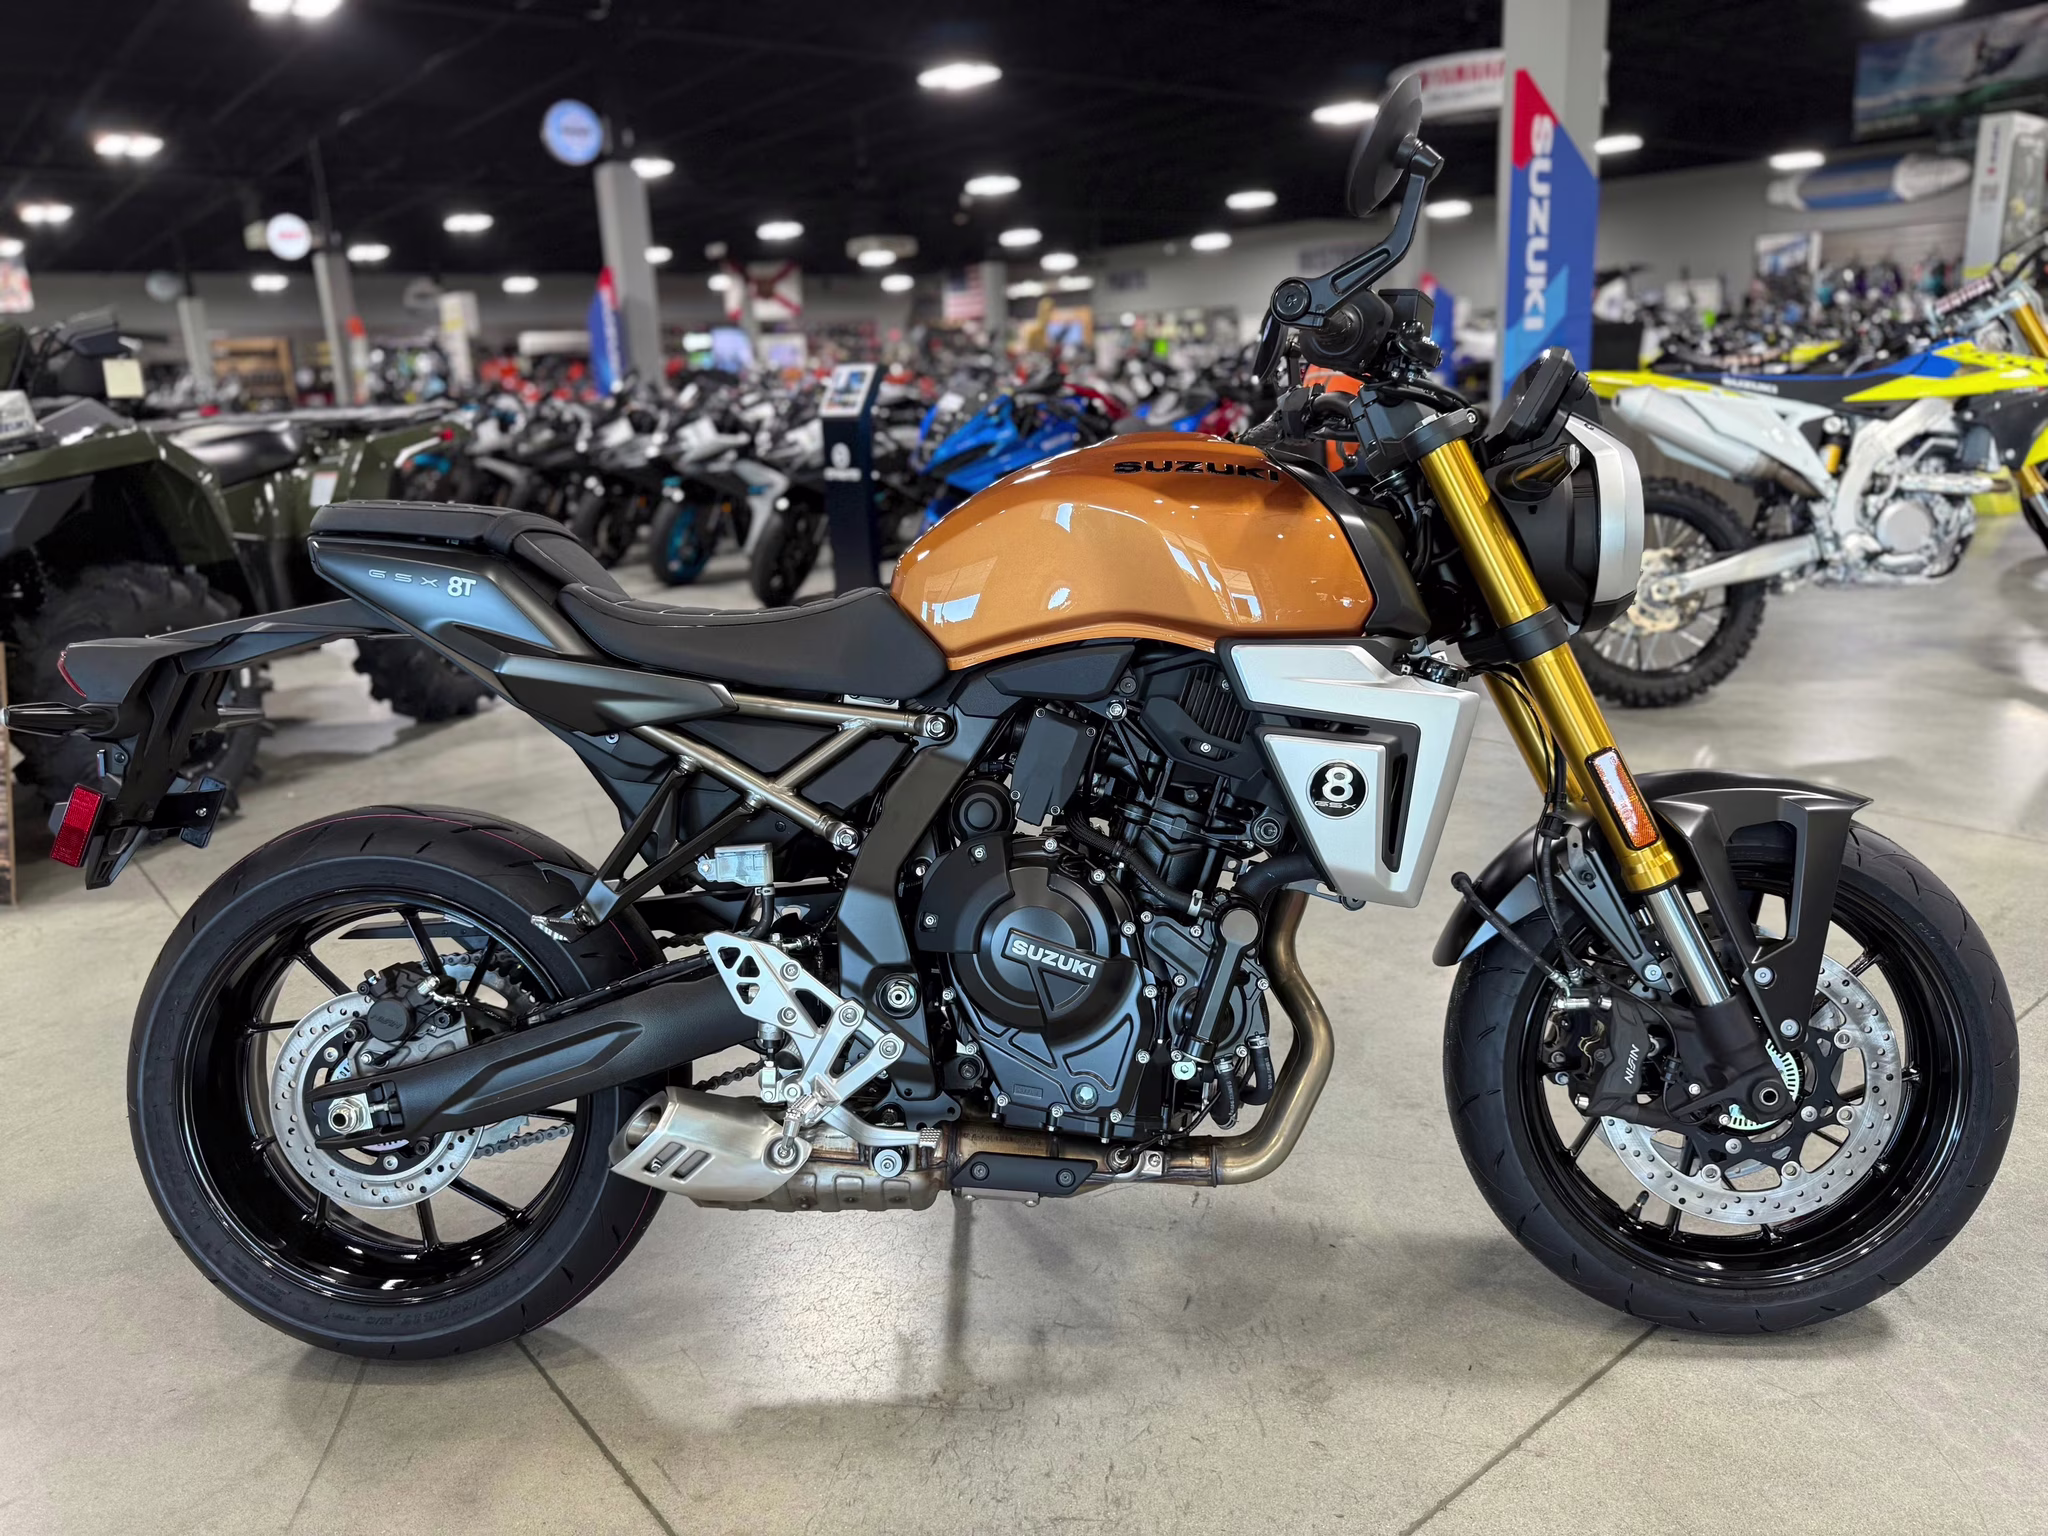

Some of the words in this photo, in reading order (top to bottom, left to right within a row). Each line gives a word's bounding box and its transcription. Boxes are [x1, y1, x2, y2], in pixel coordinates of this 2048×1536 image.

[1523, 114, 1554, 332] SUZUKI
[1113, 460, 1279, 482] SUZUKI
[368, 569, 438, 588] GSX
[447, 576, 477, 597] 8T
[1322, 767, 1353, 802] 8
[1314, 800, 1357, 810] GSX
[1012, 940, 1097, 978] SUZUKI
